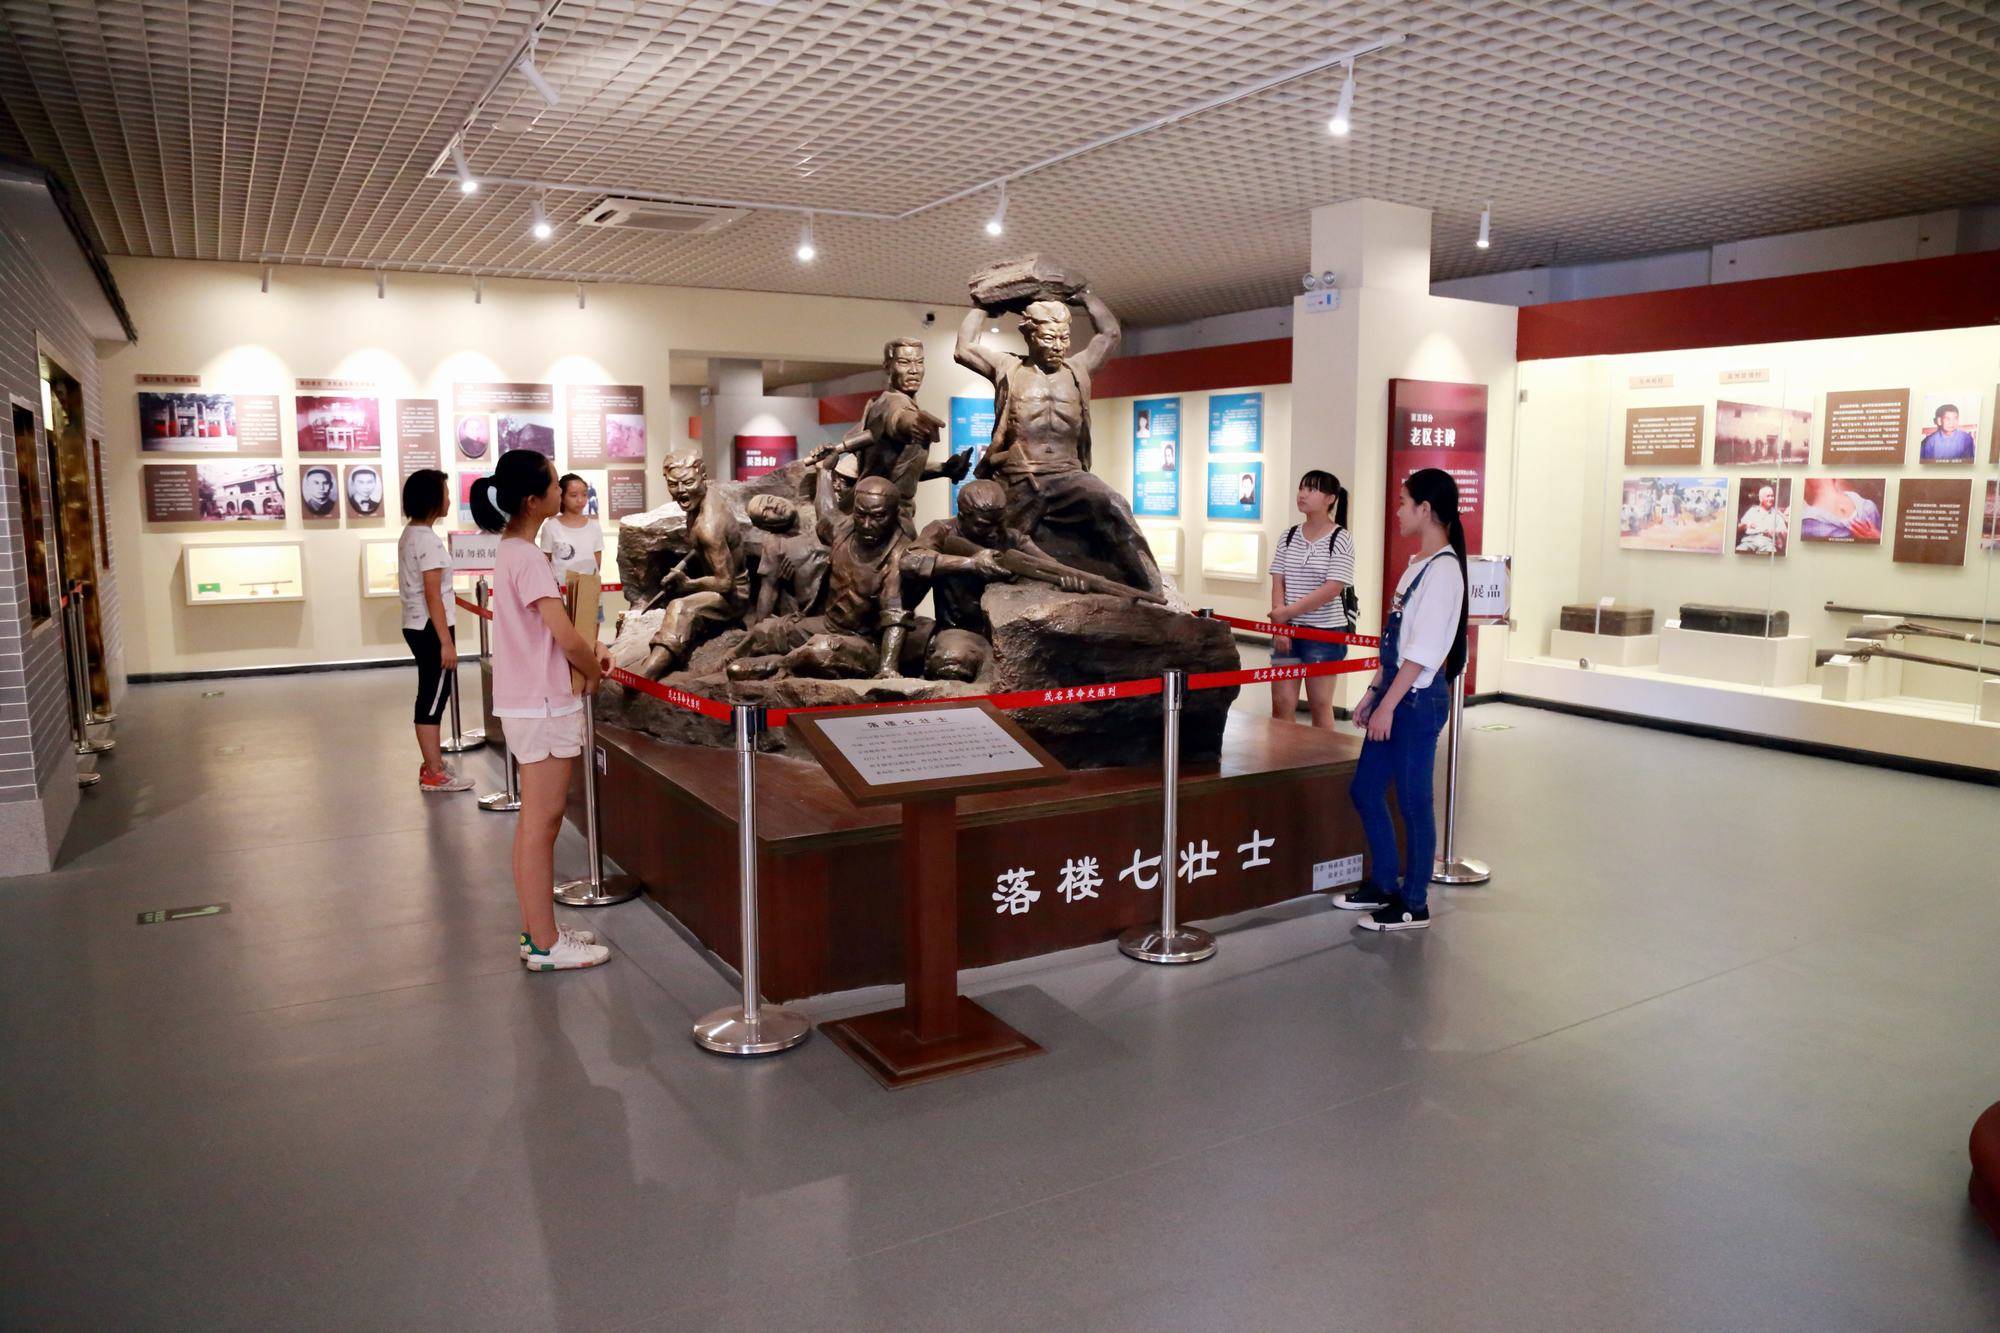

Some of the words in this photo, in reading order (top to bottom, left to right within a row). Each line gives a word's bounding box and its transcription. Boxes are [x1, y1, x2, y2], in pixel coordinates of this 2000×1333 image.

[1410, 427, 1456, 447] 老区丰碑
[1471, 584, 1501, 598] 展品
[1253, 667, 1307, 681] 茂名革命史陈列
[1044, 686, 1116, 702] 茂名革命史陈列
[991, 829, 1275, 915] 落楼七壮士
